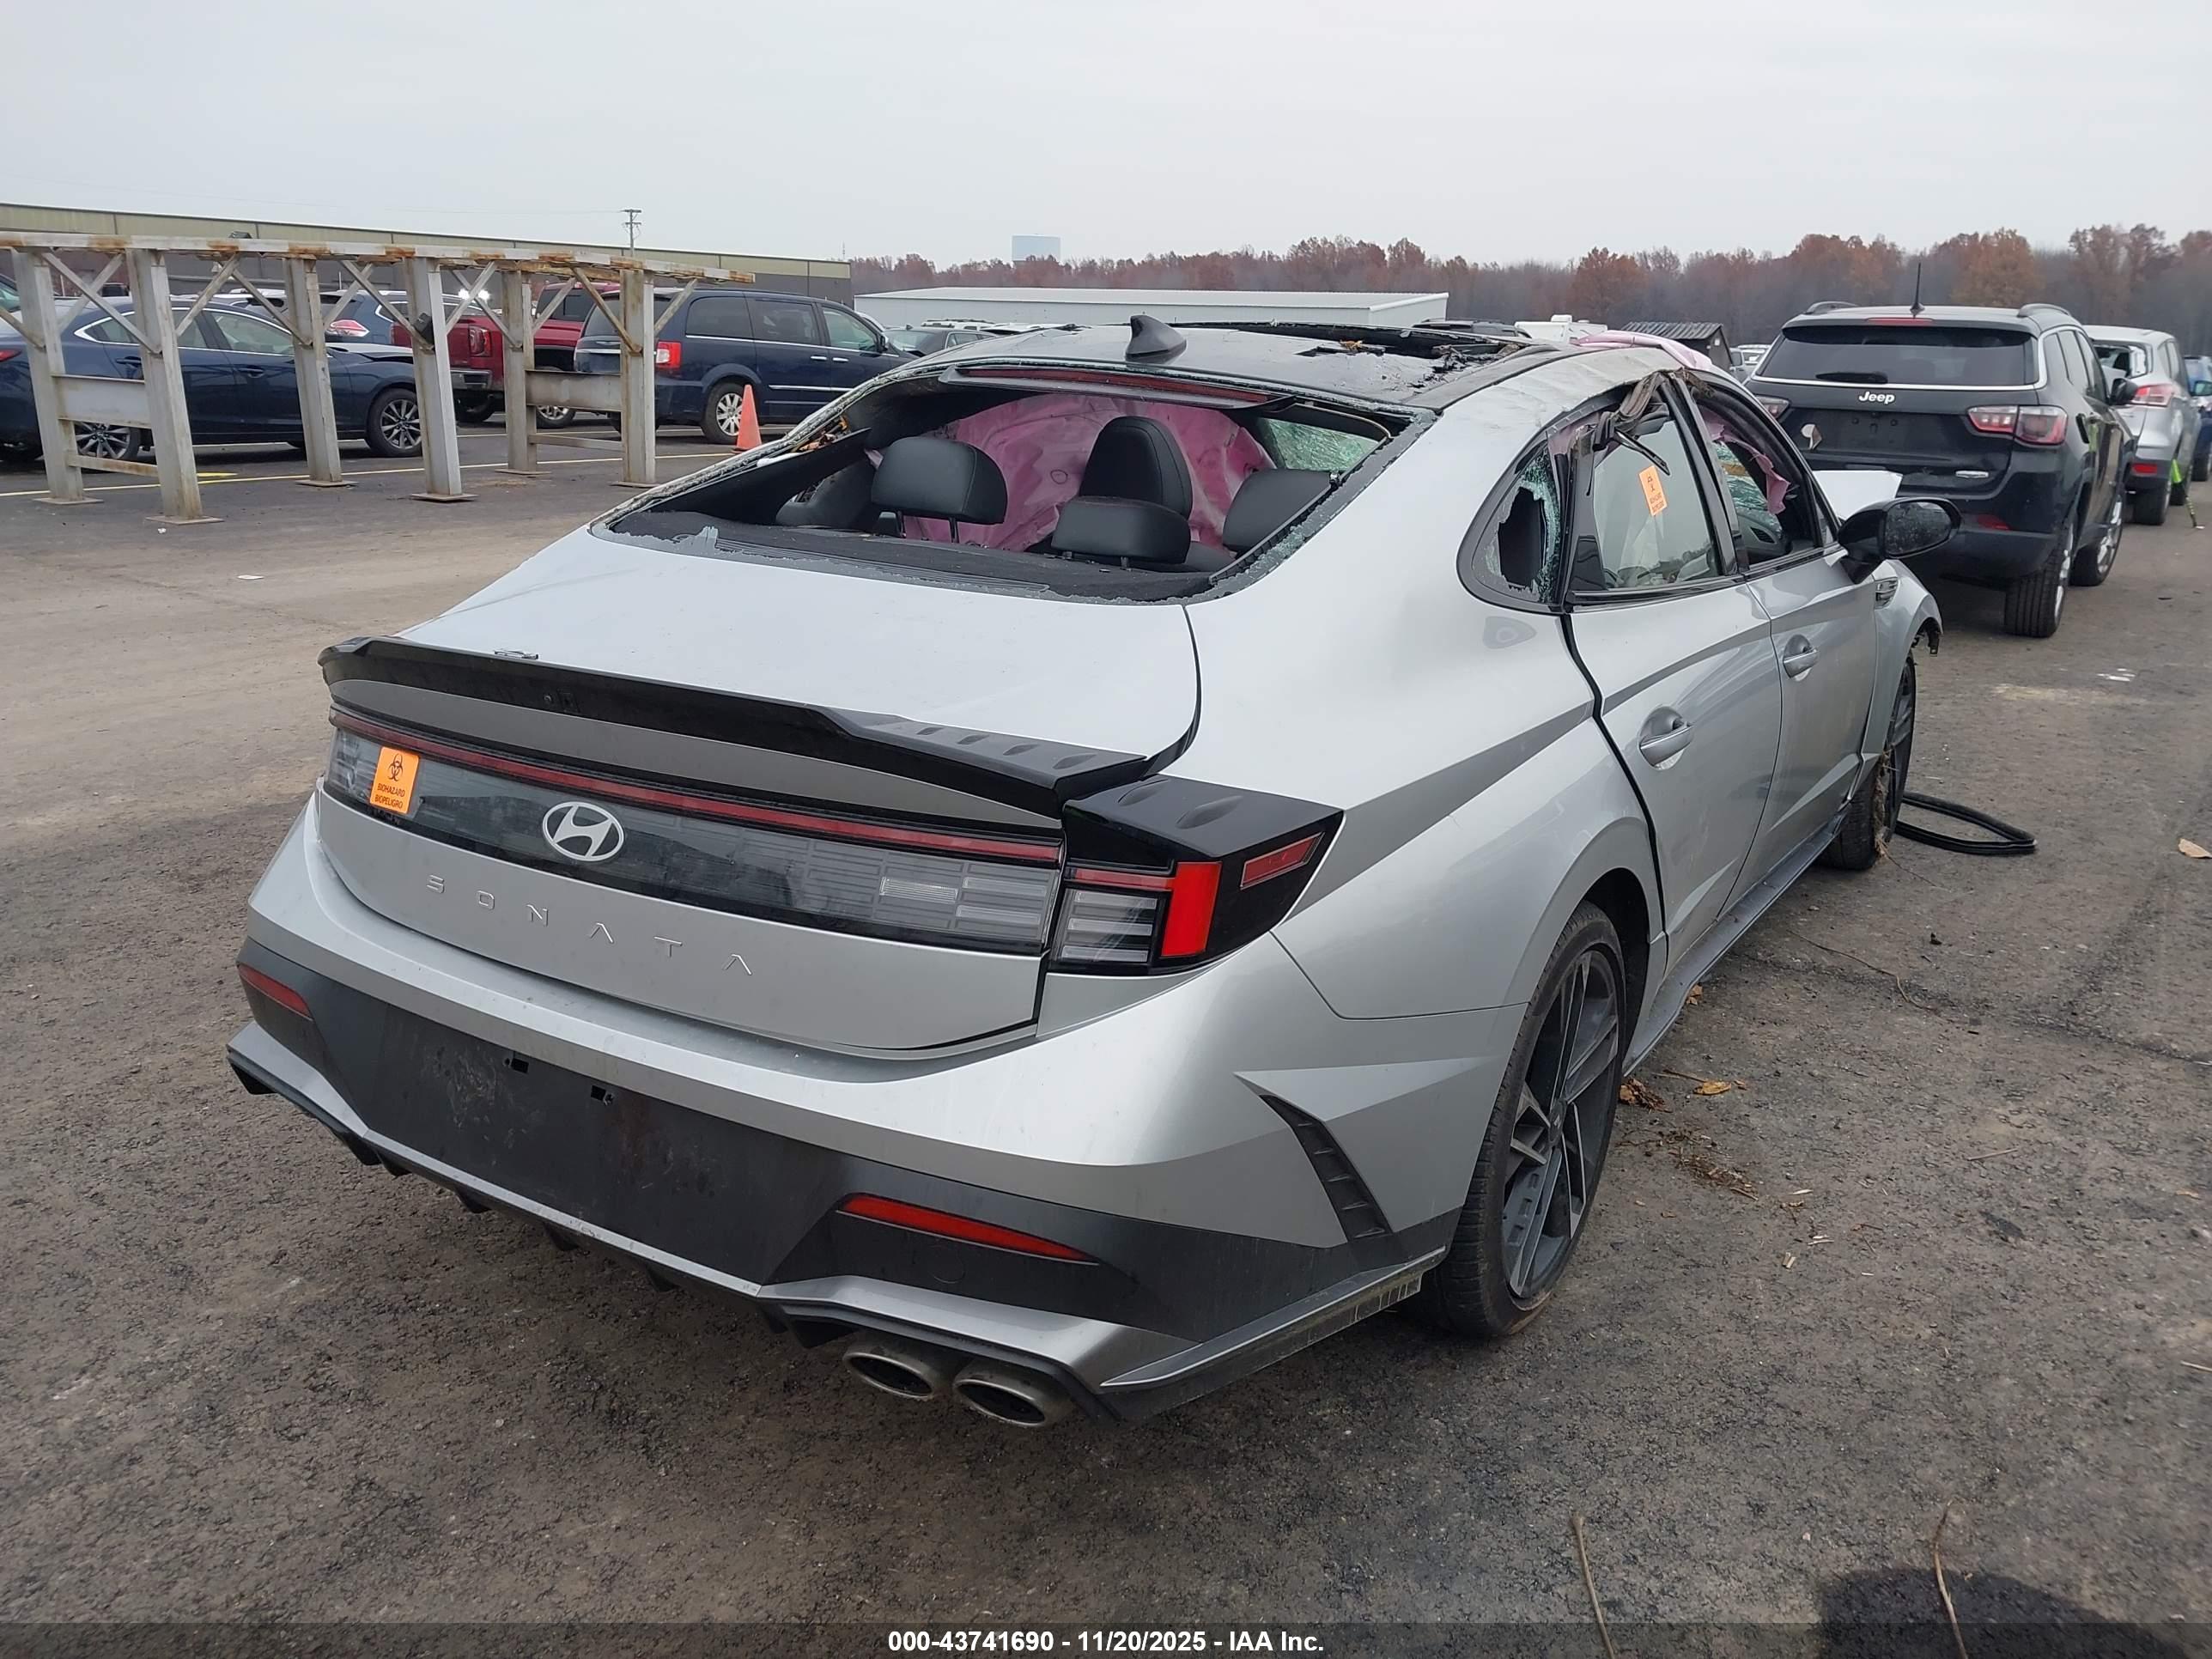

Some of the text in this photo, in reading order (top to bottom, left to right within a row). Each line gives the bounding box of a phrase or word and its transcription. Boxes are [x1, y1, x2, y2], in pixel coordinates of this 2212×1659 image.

[1858, 391, 1895, 404] Jeep
[377, 782, 405, 798] BIOHAZARD
[374, 793, 404, 809] BIOPELIGRO
[427, 874, 752, 975] SONATA
